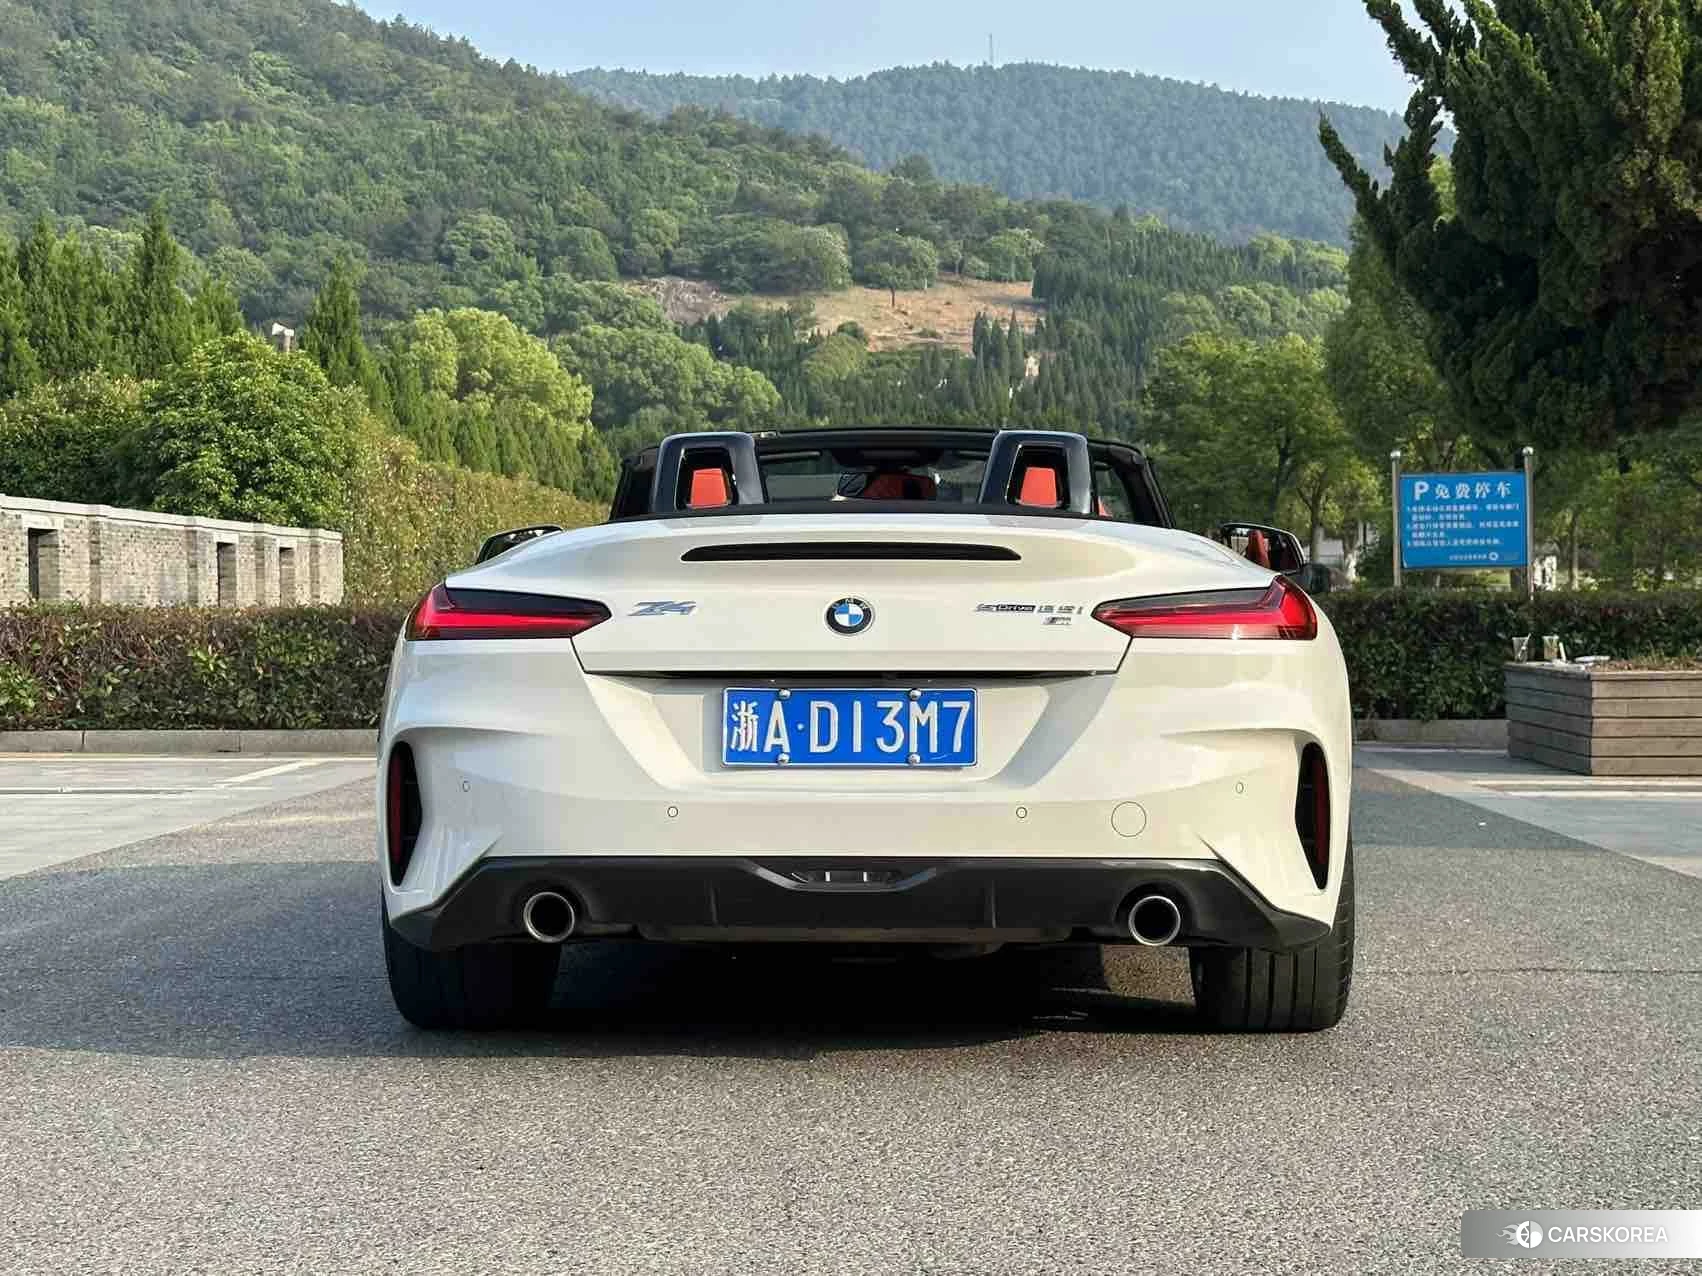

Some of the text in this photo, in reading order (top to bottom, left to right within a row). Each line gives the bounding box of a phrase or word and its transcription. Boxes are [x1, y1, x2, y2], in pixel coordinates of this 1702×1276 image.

[1414, 481, 1512, 500] P 免费停车
